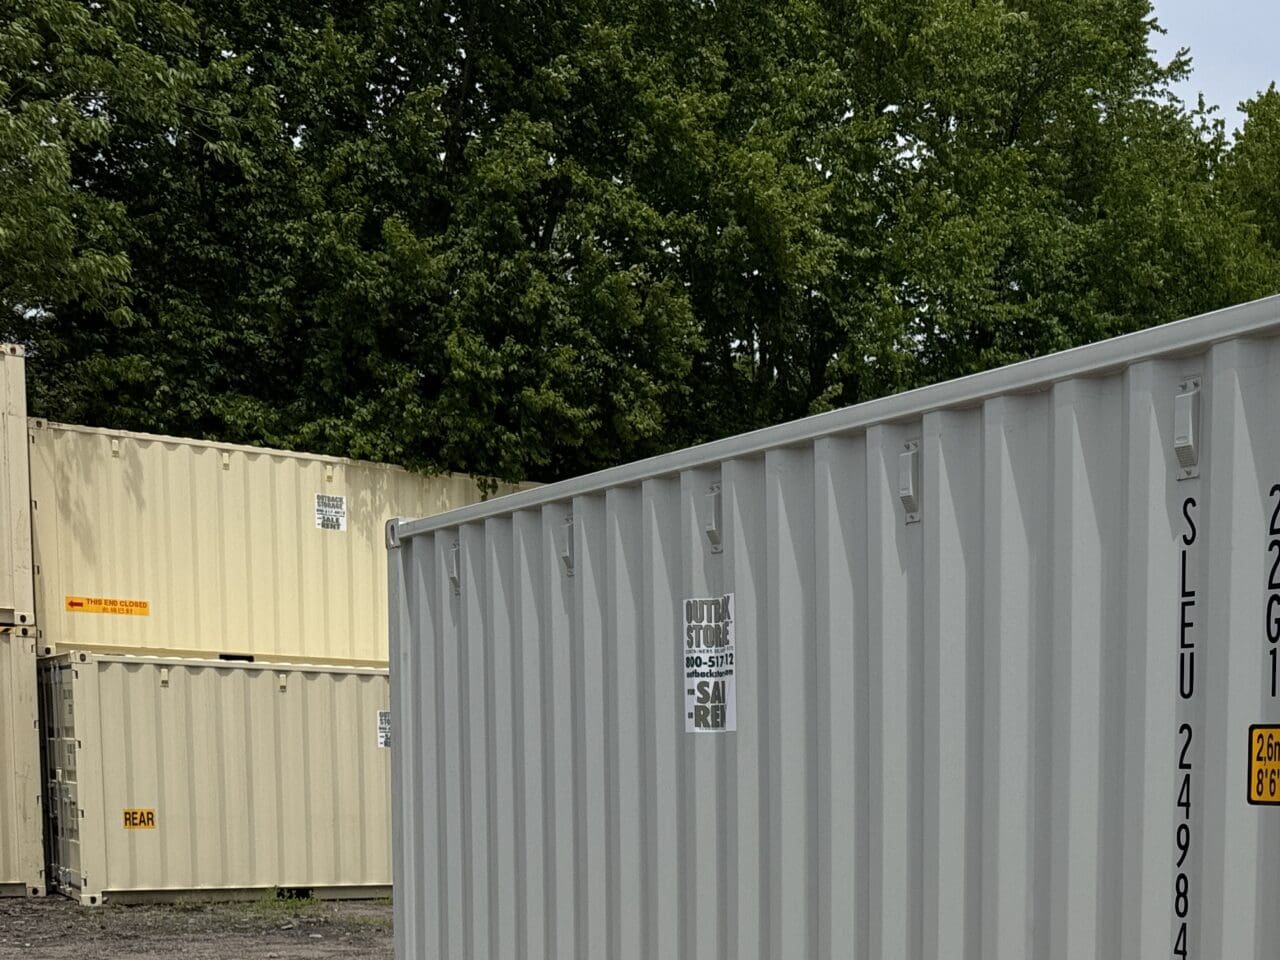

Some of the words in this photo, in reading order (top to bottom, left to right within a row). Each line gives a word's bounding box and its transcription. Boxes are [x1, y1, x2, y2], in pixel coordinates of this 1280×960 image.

[86, 598, 102, 606] THIS
[104, 599, 118, 607] END
[119, 600, 147, 608] CLOSED
[1176, 496, 1197, 699] SLEU
[124, 811, 155, 826] REAR
